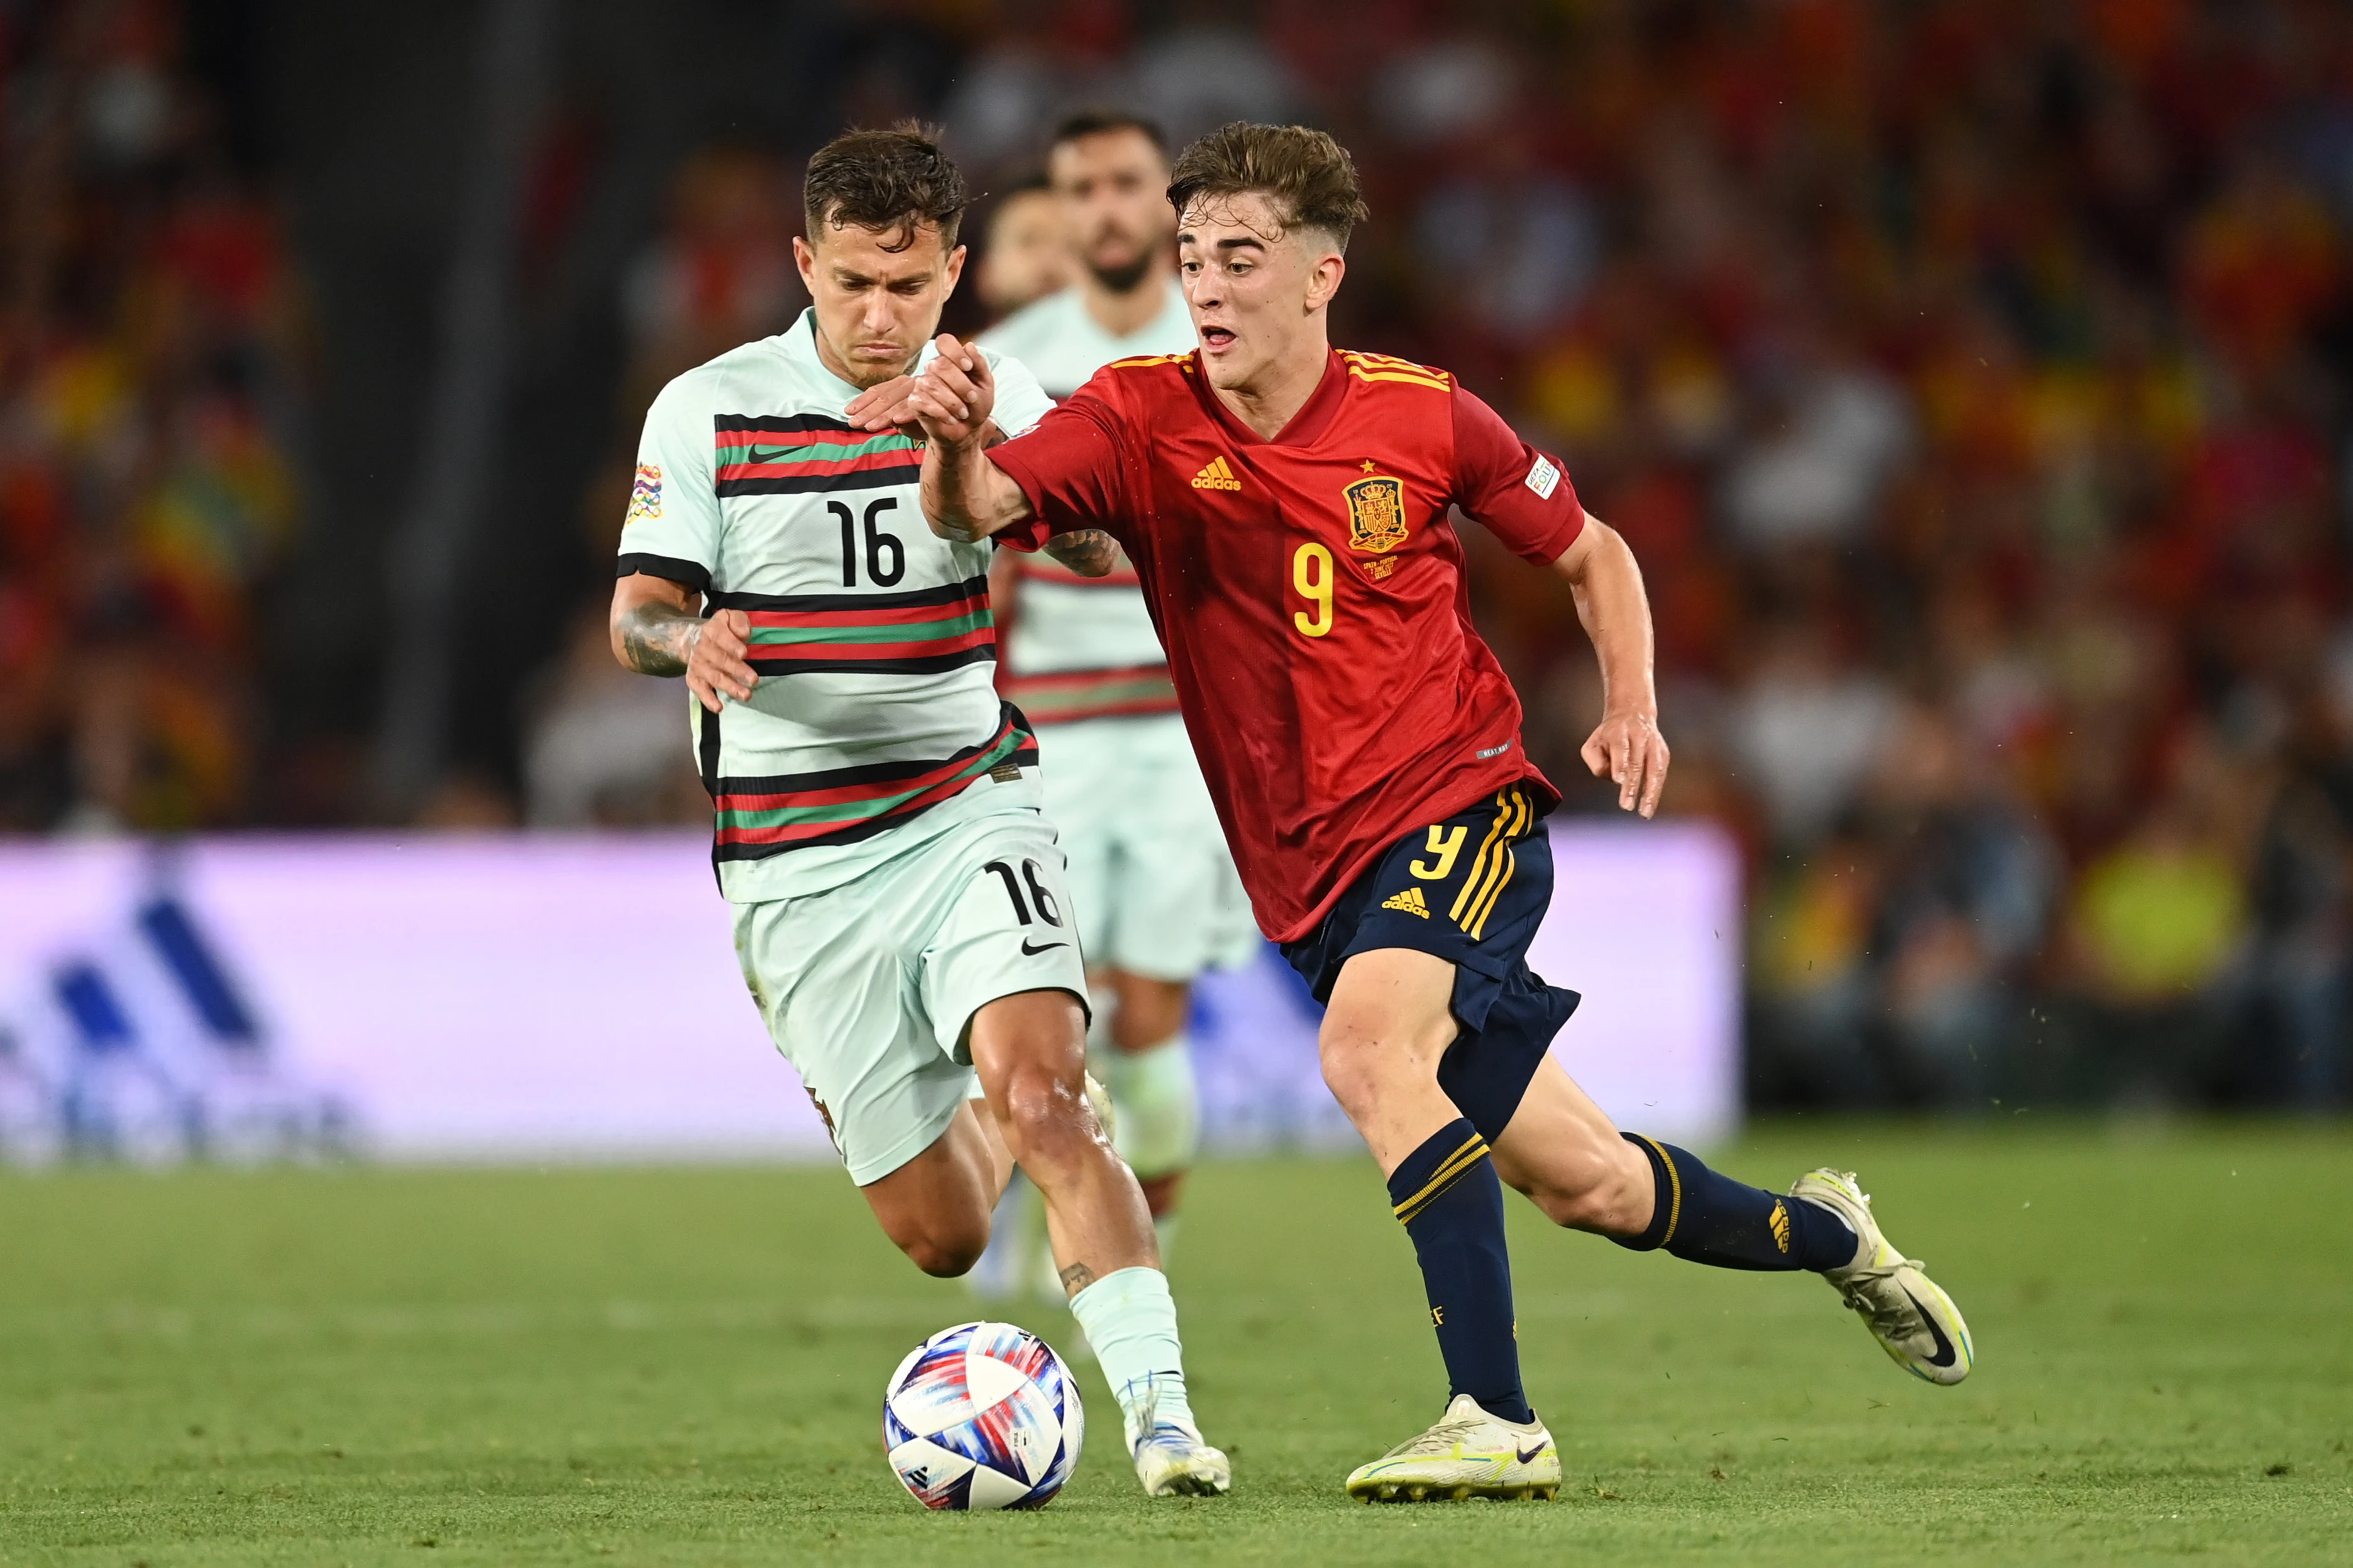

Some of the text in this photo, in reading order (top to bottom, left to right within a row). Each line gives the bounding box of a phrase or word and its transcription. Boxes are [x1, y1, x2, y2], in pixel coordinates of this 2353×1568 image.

[1191, 475, 1242, 491] adidas
[1528, 468, 1540, 485] UEFA
[827, 496, 905, 588] 16
[1380, 555, 1398, 565] PORTUGAL
[1293, 542, 1333, 637] 9
[1374, 569, 1392, 579] SEVILLE
[1409, 825, 1468, 880] 9
[983, 858, 1064, 928] 16
[1381, 897, 1431, 920] adidas
[1775, 1198, 1790, 1254] adidas
